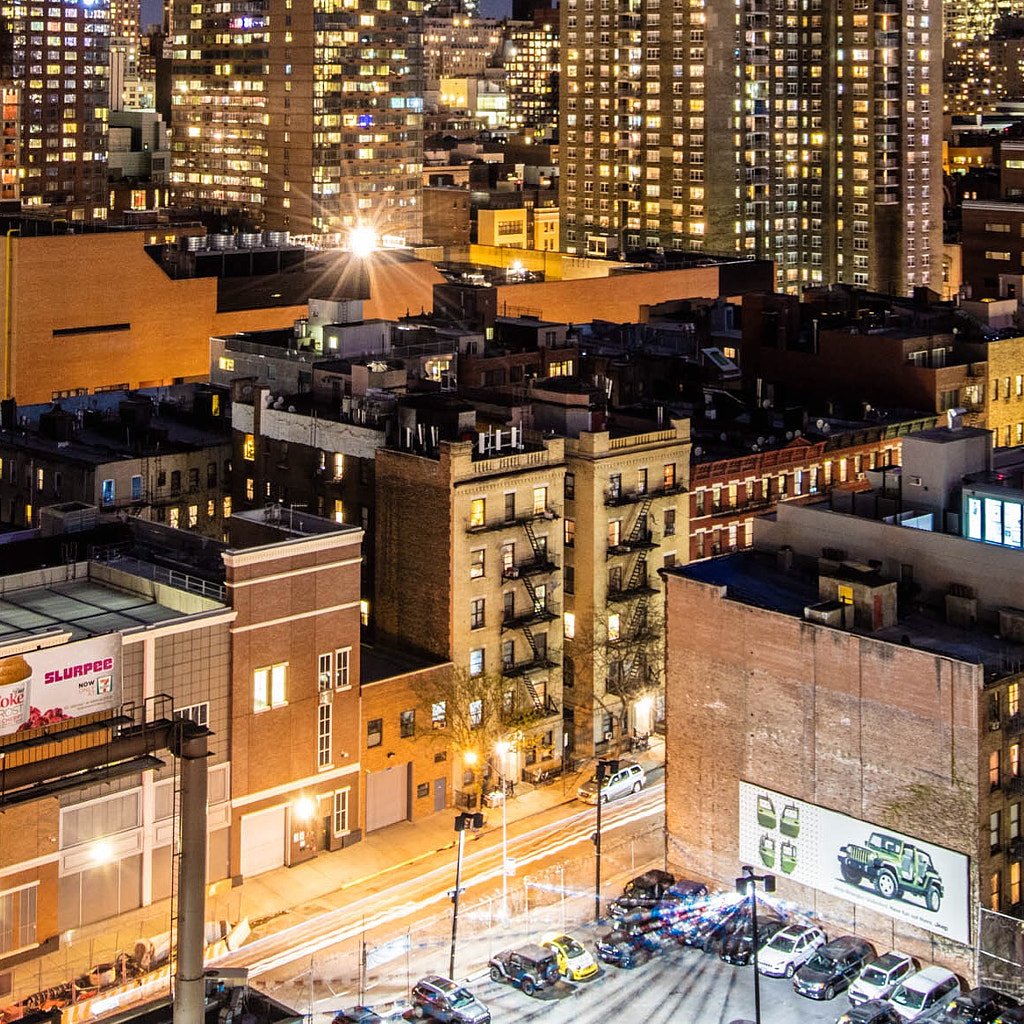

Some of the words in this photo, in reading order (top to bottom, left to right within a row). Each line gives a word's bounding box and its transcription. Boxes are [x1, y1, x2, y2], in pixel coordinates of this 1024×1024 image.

[45, 658, 113, 684] SLURPEE
[79, 680, 95, 688] NOW
[0, 692, 24, 708] oke
